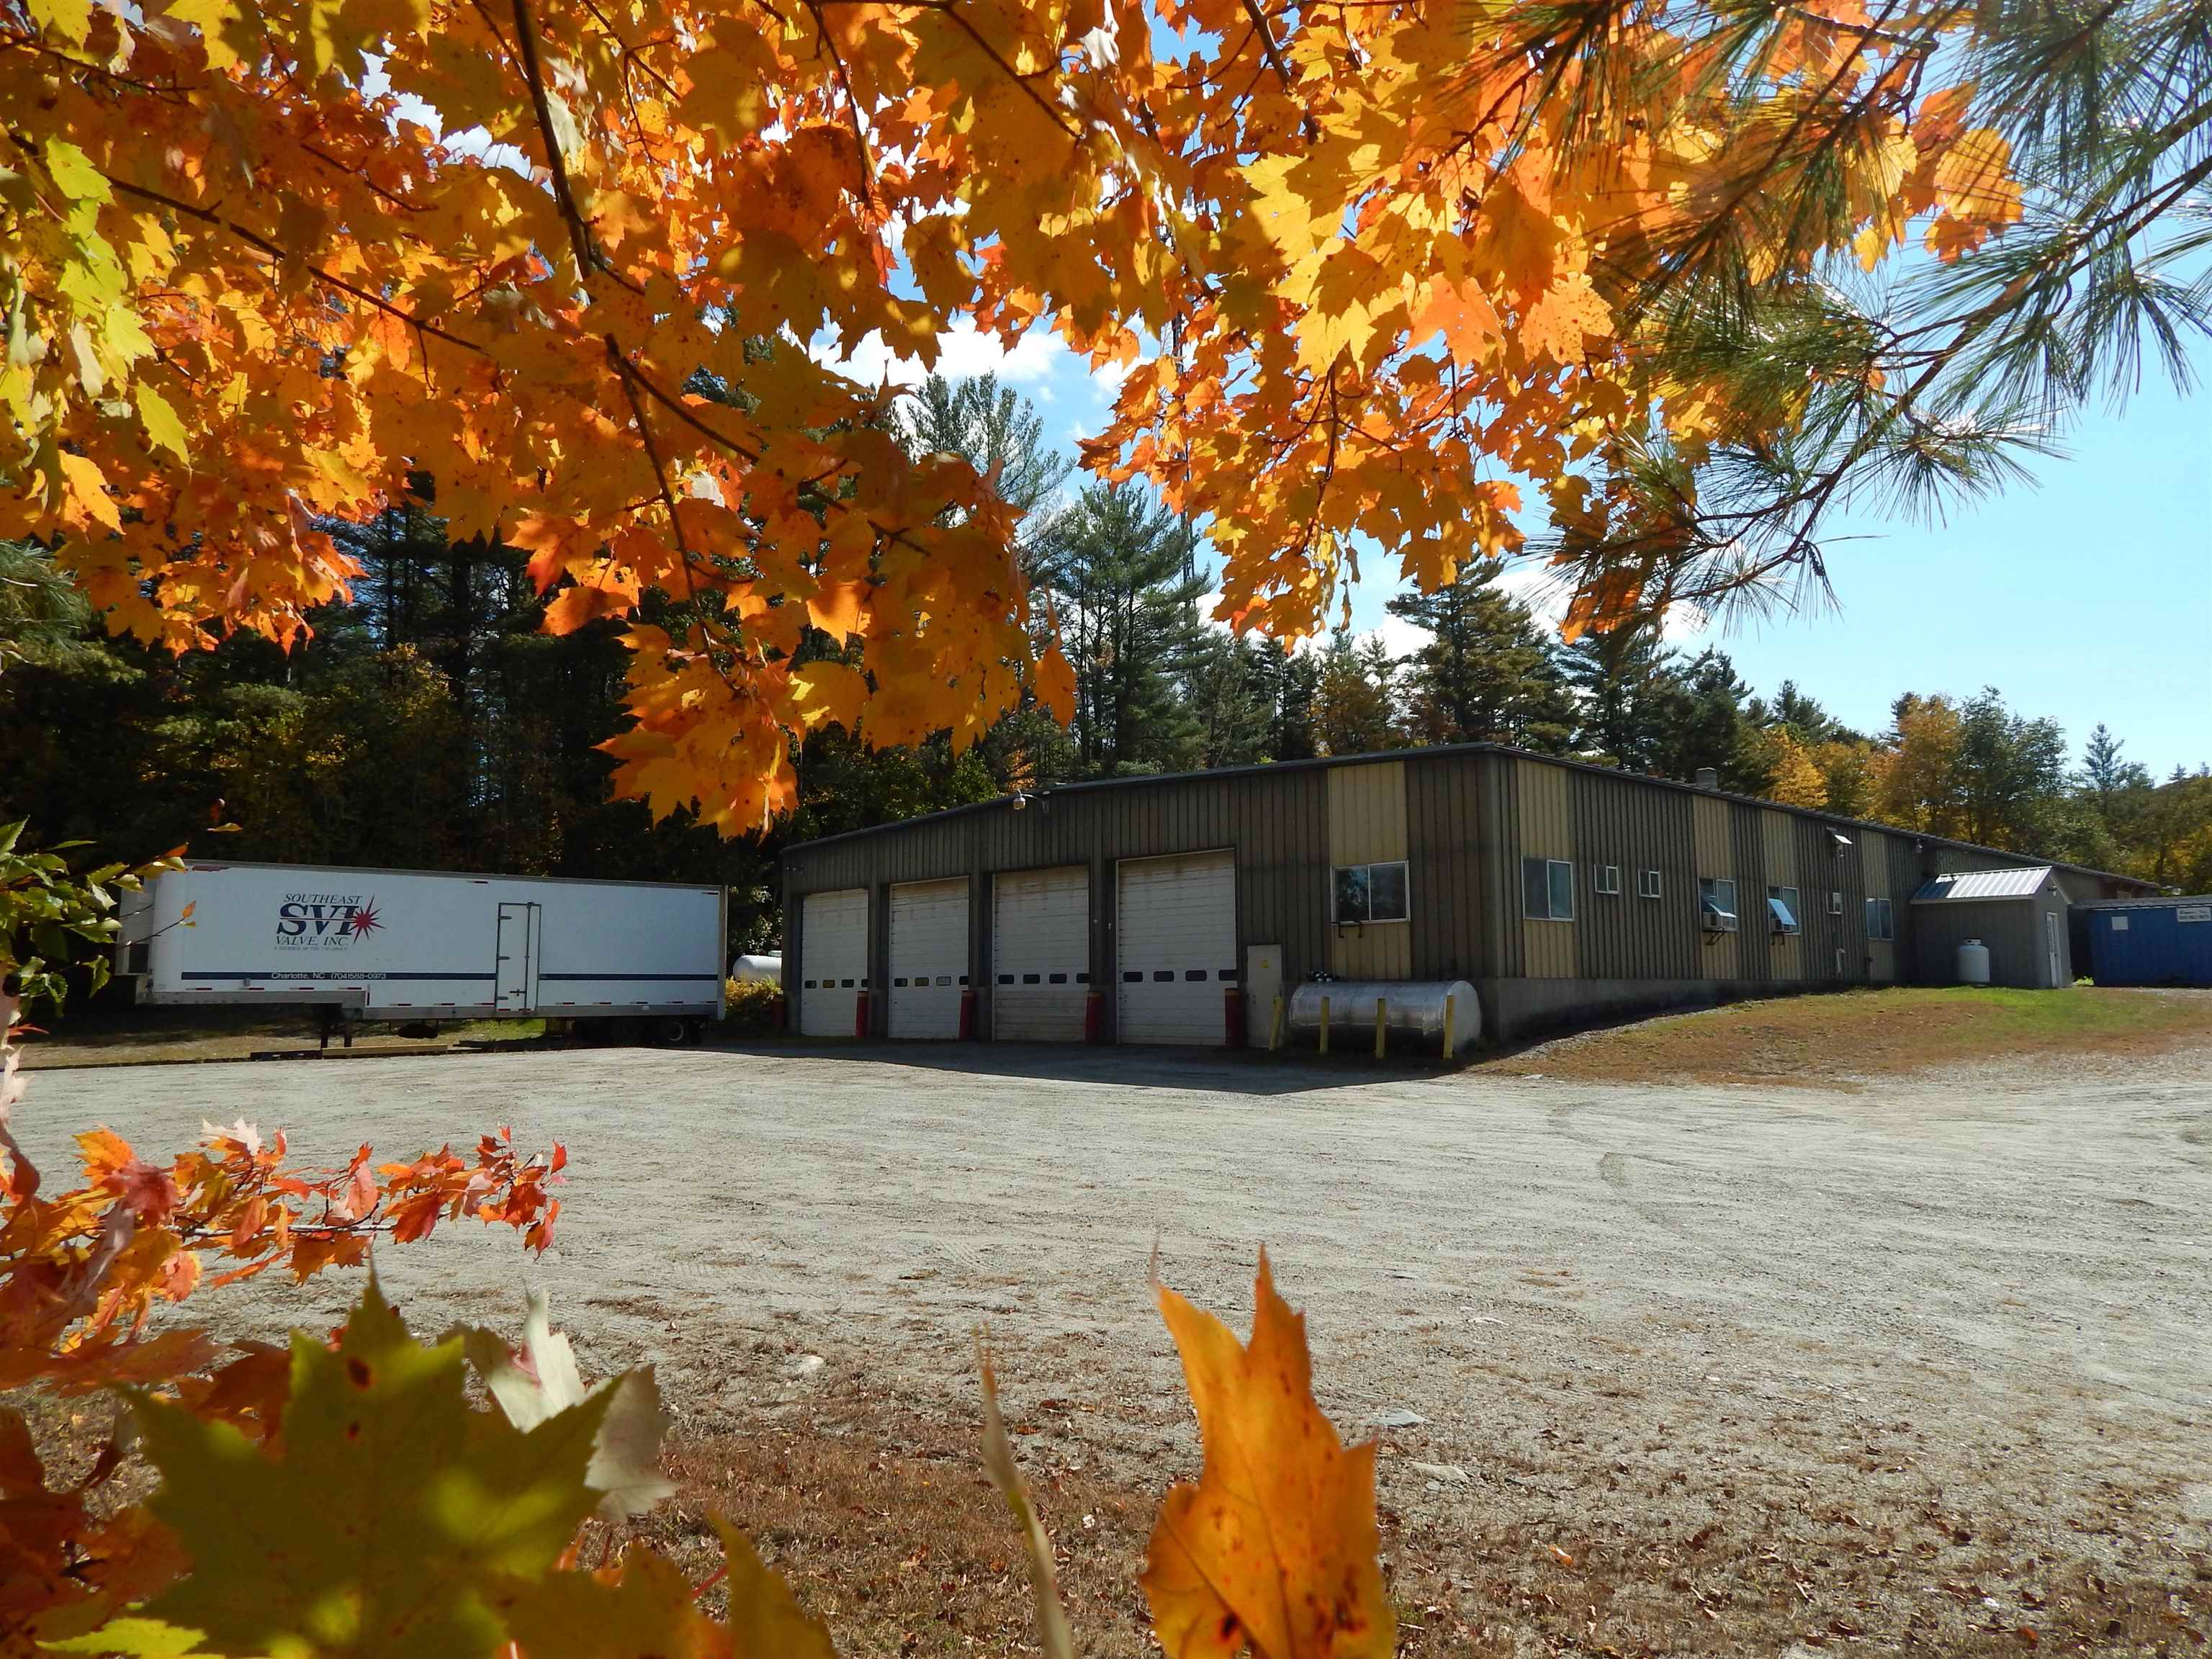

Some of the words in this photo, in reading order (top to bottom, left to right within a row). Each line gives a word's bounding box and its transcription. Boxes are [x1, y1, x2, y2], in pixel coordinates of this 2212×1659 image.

[284, 893, 363, 904] SOUTHEAST
[276, 903, 360, 936] SVI
[323, 936, 349, 946] INC.
